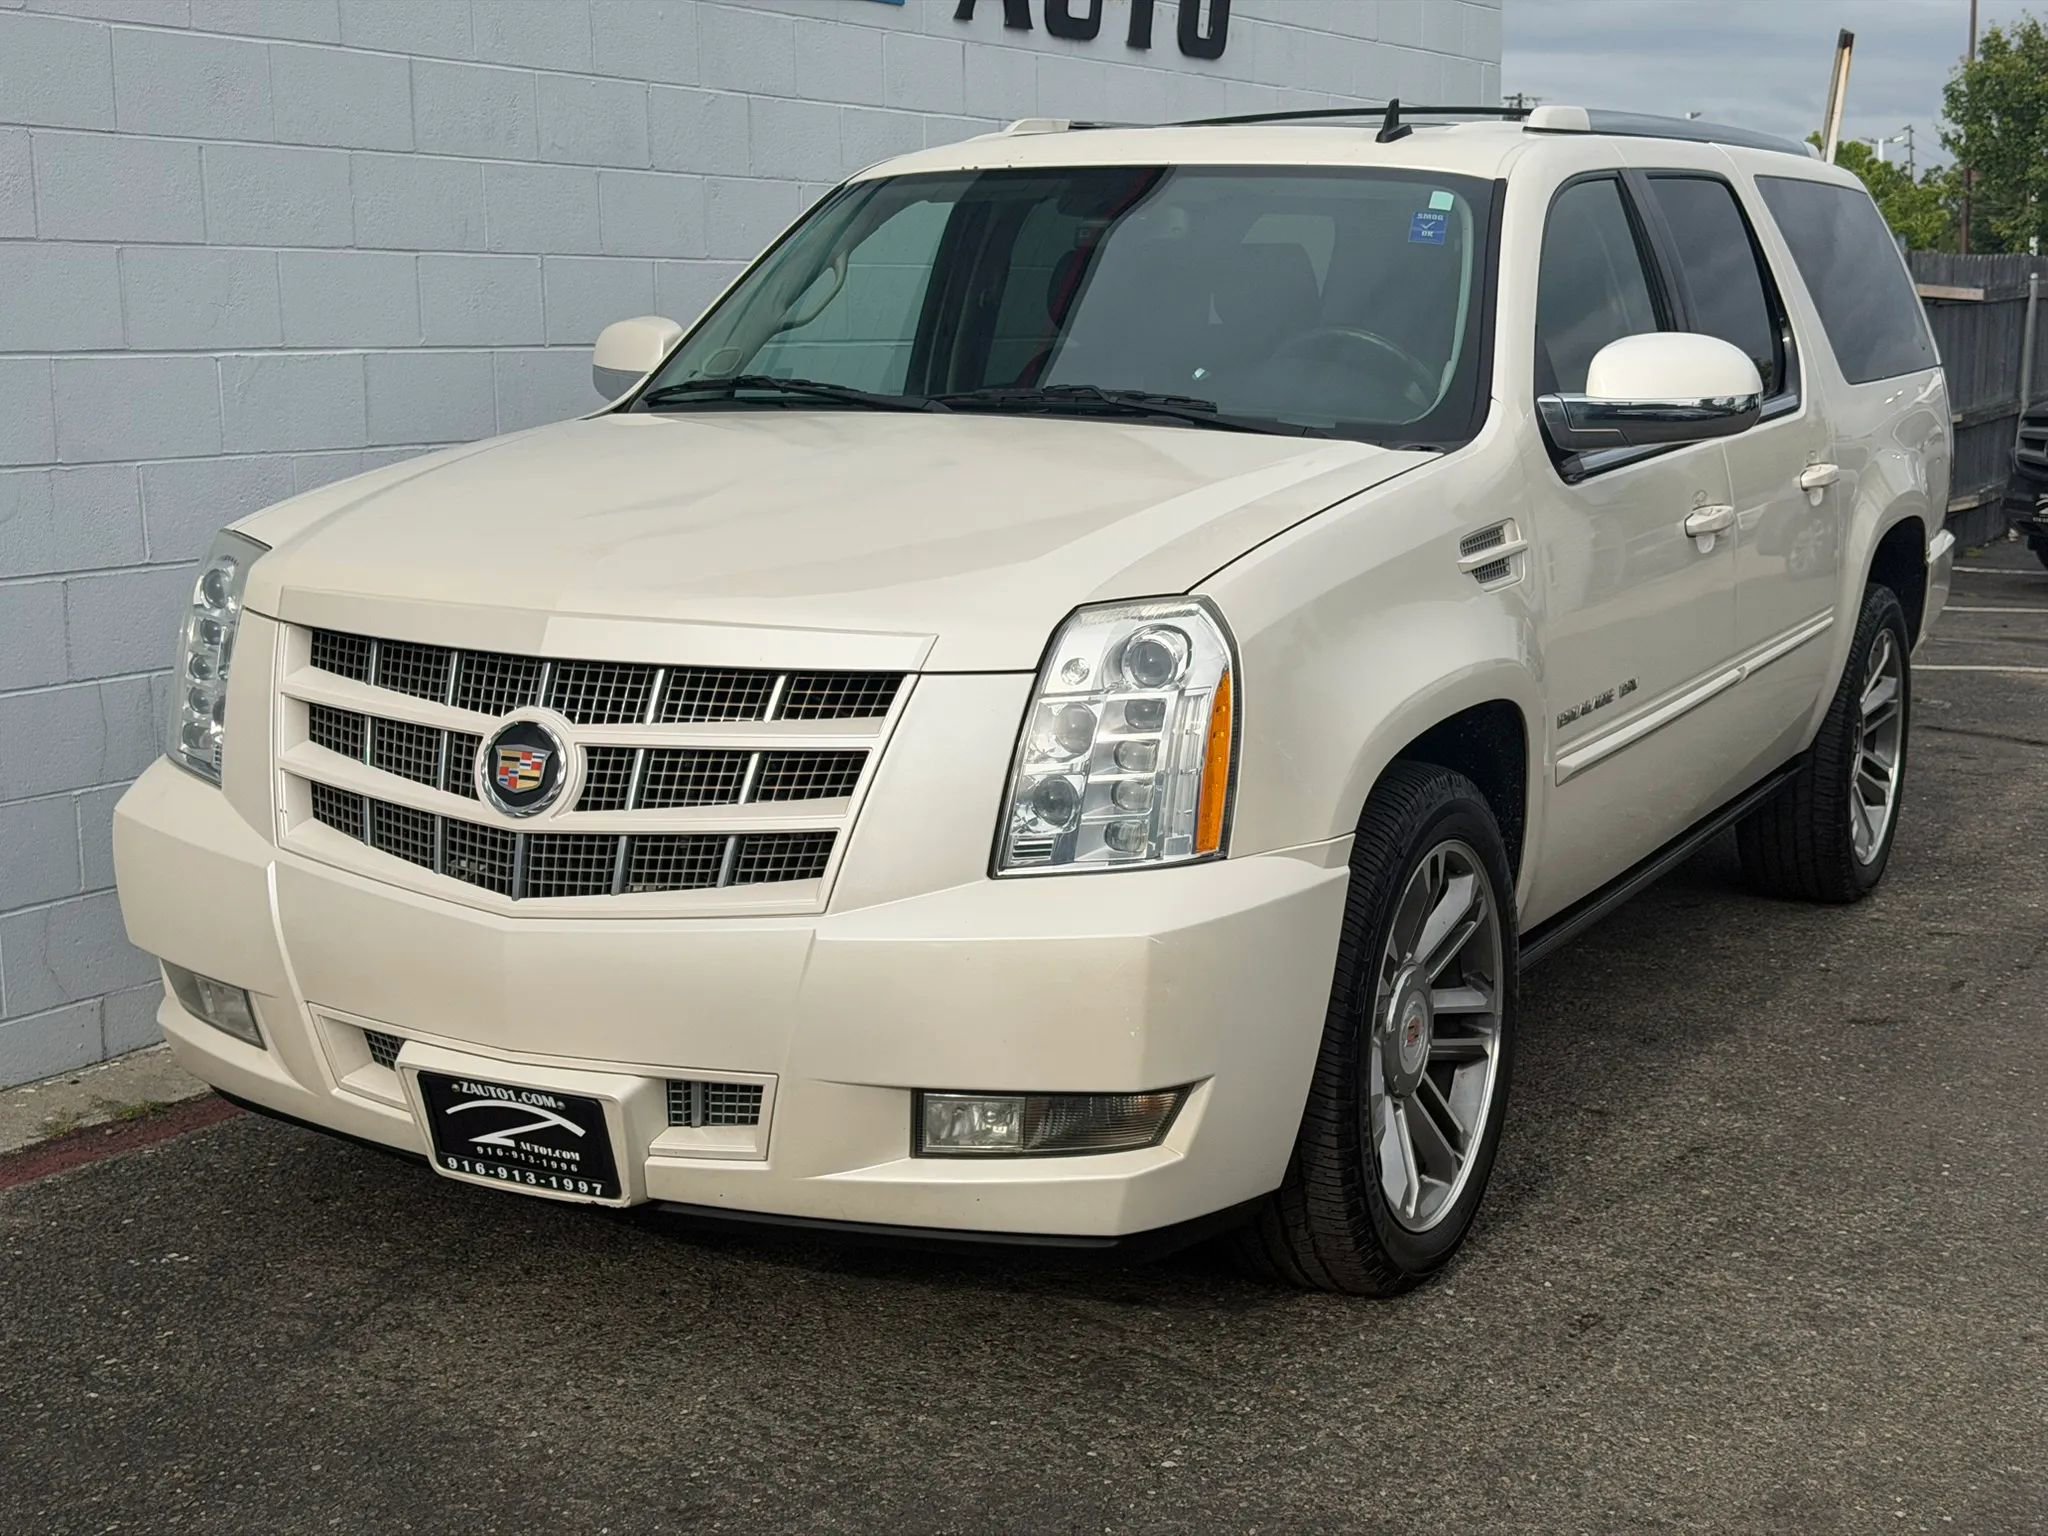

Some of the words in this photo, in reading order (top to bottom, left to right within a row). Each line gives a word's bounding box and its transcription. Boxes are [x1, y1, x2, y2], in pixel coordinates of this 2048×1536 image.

[459, 1081, 557, 1109] ZAUTO1.COM
[476, 1146, 578, 1172] 916-913-1996
[447, 1157, 603, 1195] 916-913-1997
